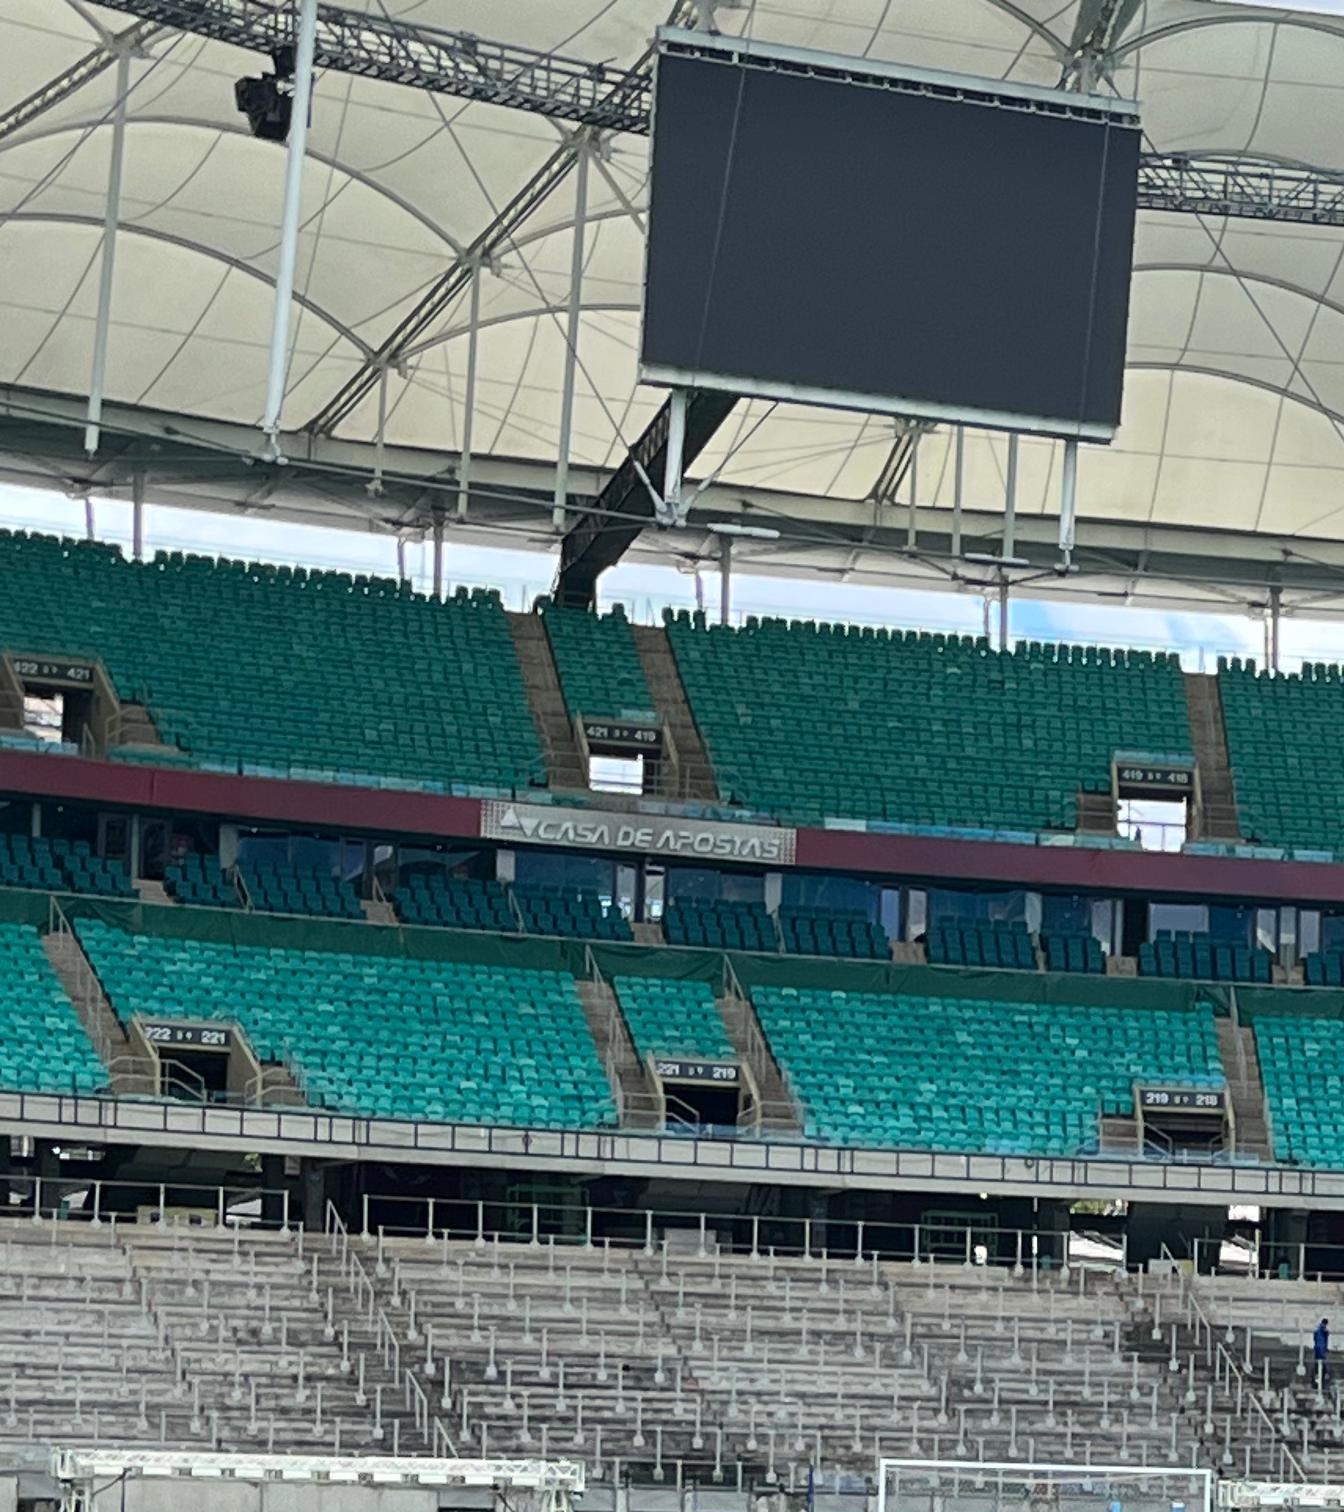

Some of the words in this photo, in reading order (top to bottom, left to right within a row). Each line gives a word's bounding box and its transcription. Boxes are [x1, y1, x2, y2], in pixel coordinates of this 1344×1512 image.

[67, 667, 90, 680] 421
[586, 726, 608, 738] 421
[538, 820, 610, 844] CASA
[617, 826, 653, 848] DE
[657, 831, 780, 858] APOSTAS
[201, 1030, 226, 1045] 221
[712, 1066, 737, 1080] 219
[1145, 1092, 1169, 1104] 219
